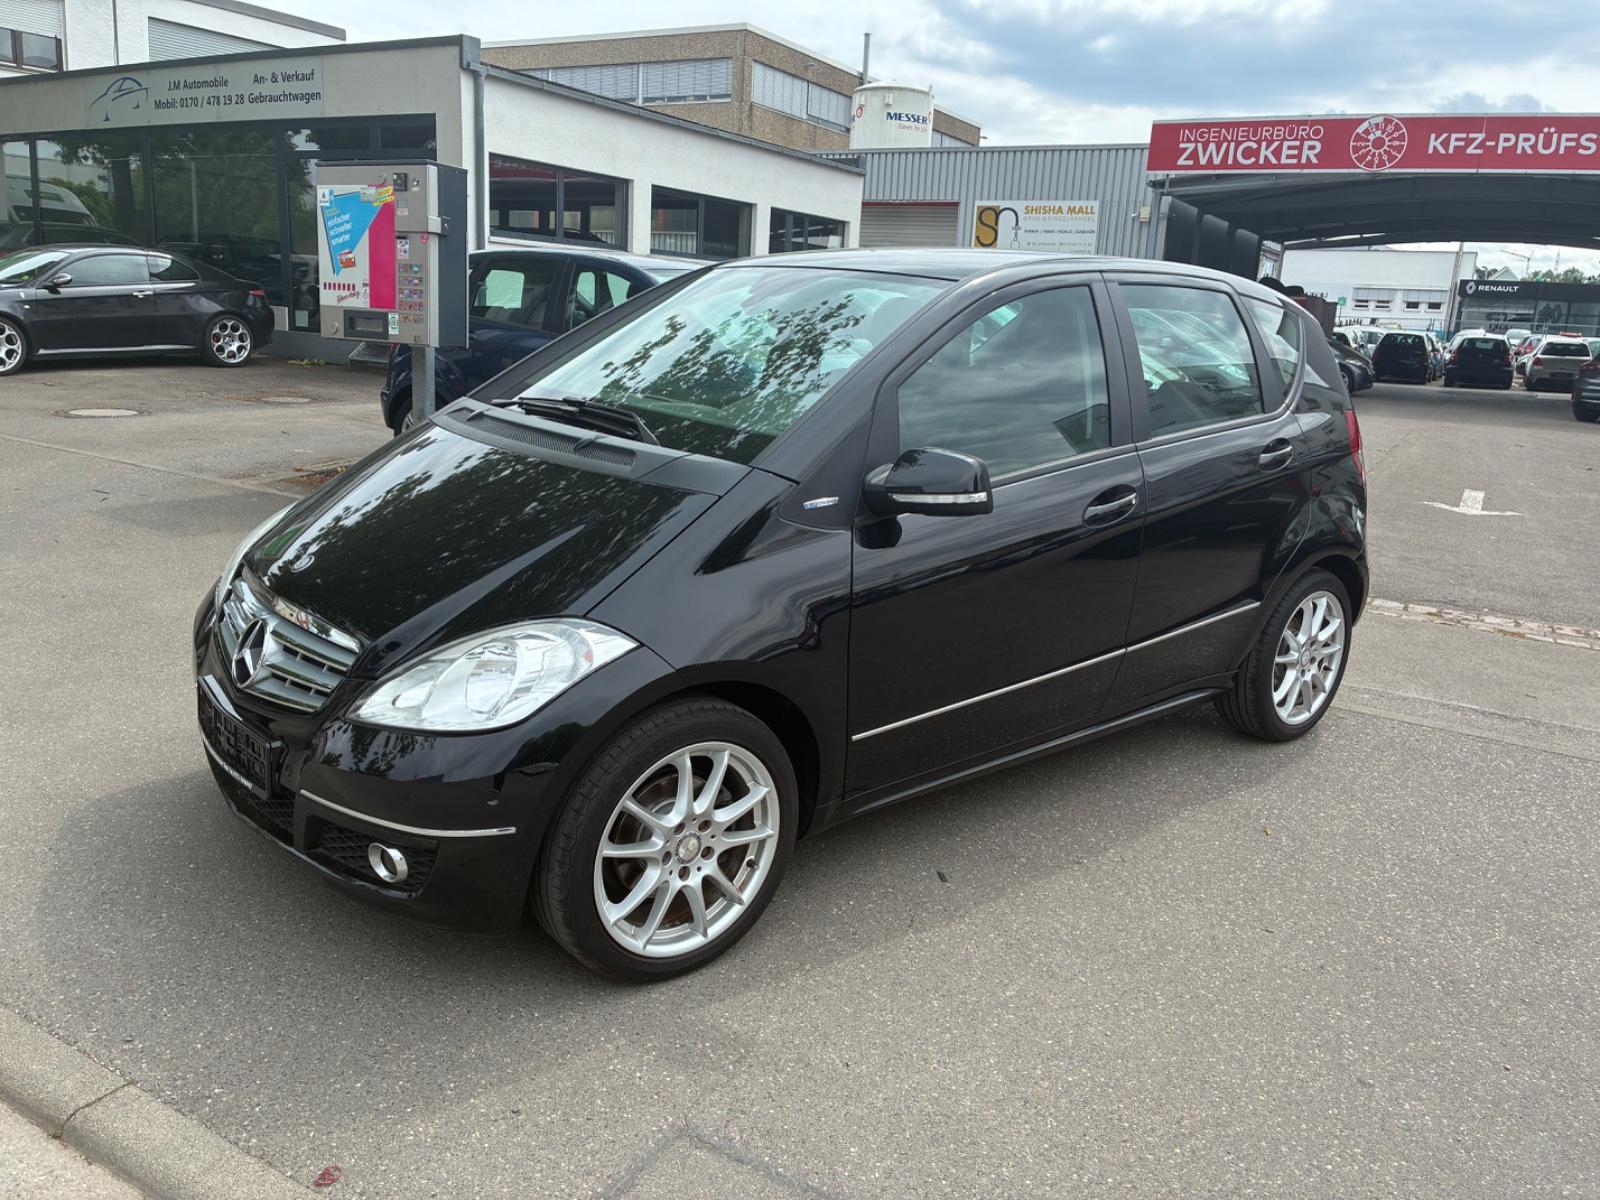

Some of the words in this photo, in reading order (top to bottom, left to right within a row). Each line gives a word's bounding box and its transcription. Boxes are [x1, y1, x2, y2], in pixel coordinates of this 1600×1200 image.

[168, 80, 181, 91] J.M
[183, 76, 229, 90] Automobile
[253, 73, 268, 85] An-
[270, 72, 279, 84] &
[281, 69, 315, 82] Verkauf
[154, 98, 178, 110] Mobil:
[180, 96, 199, 108] 0170
[206, 95, 221, 106] 478
[223, 94, 233, 106] 19
[234, 93, 245, 105] 28
[248, 91, 322, 104] Gebrauchtwagen
[886, 112, 928, 125] MESSER
[1179, 124, 1324, 142] INGENIEURBÜRO
[1176, 140, 1322, 166] ZWICKER
[1024, 205, 1064, 215] SHISHA
[1066, 205, 1096, 215] MALL
[1478, 284, 1519, 292] RENAULT
